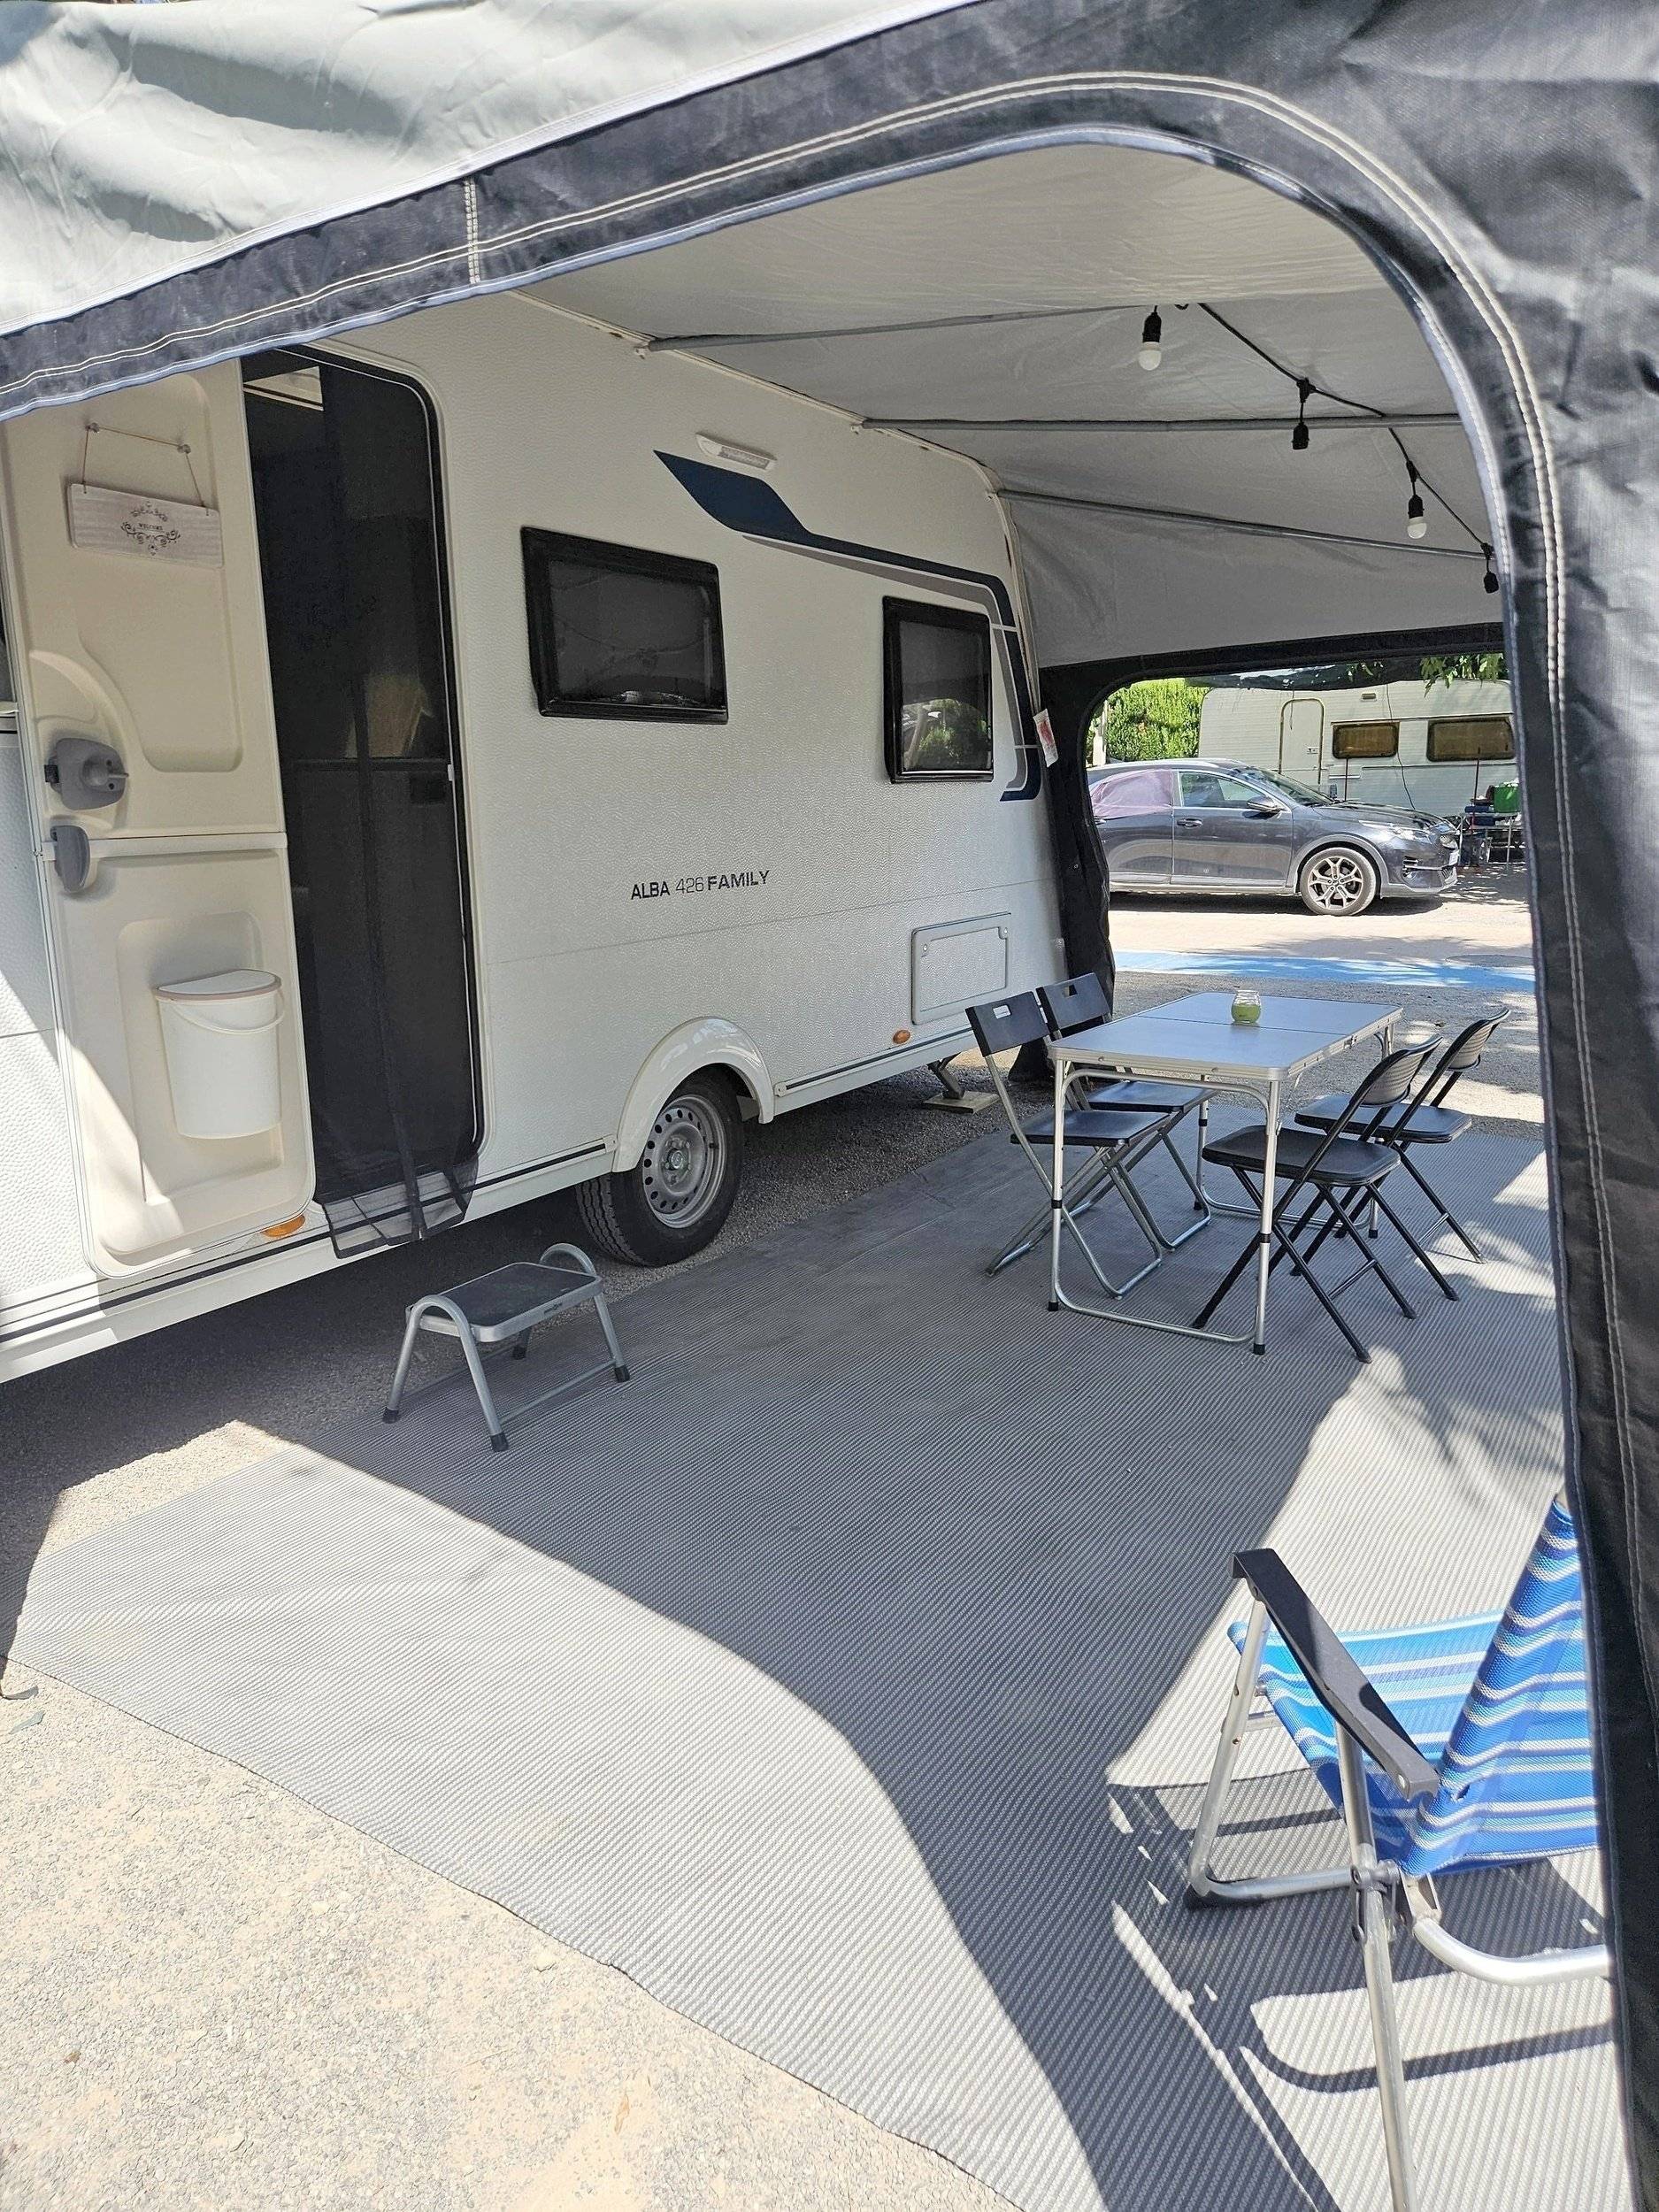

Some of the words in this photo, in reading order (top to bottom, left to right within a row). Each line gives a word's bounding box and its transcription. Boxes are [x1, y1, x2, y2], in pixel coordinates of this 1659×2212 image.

[631, 881, 671, 900] ALBA
[675, 877, 704, 895] 426
[707, 870, 770, 891] FAMILY
